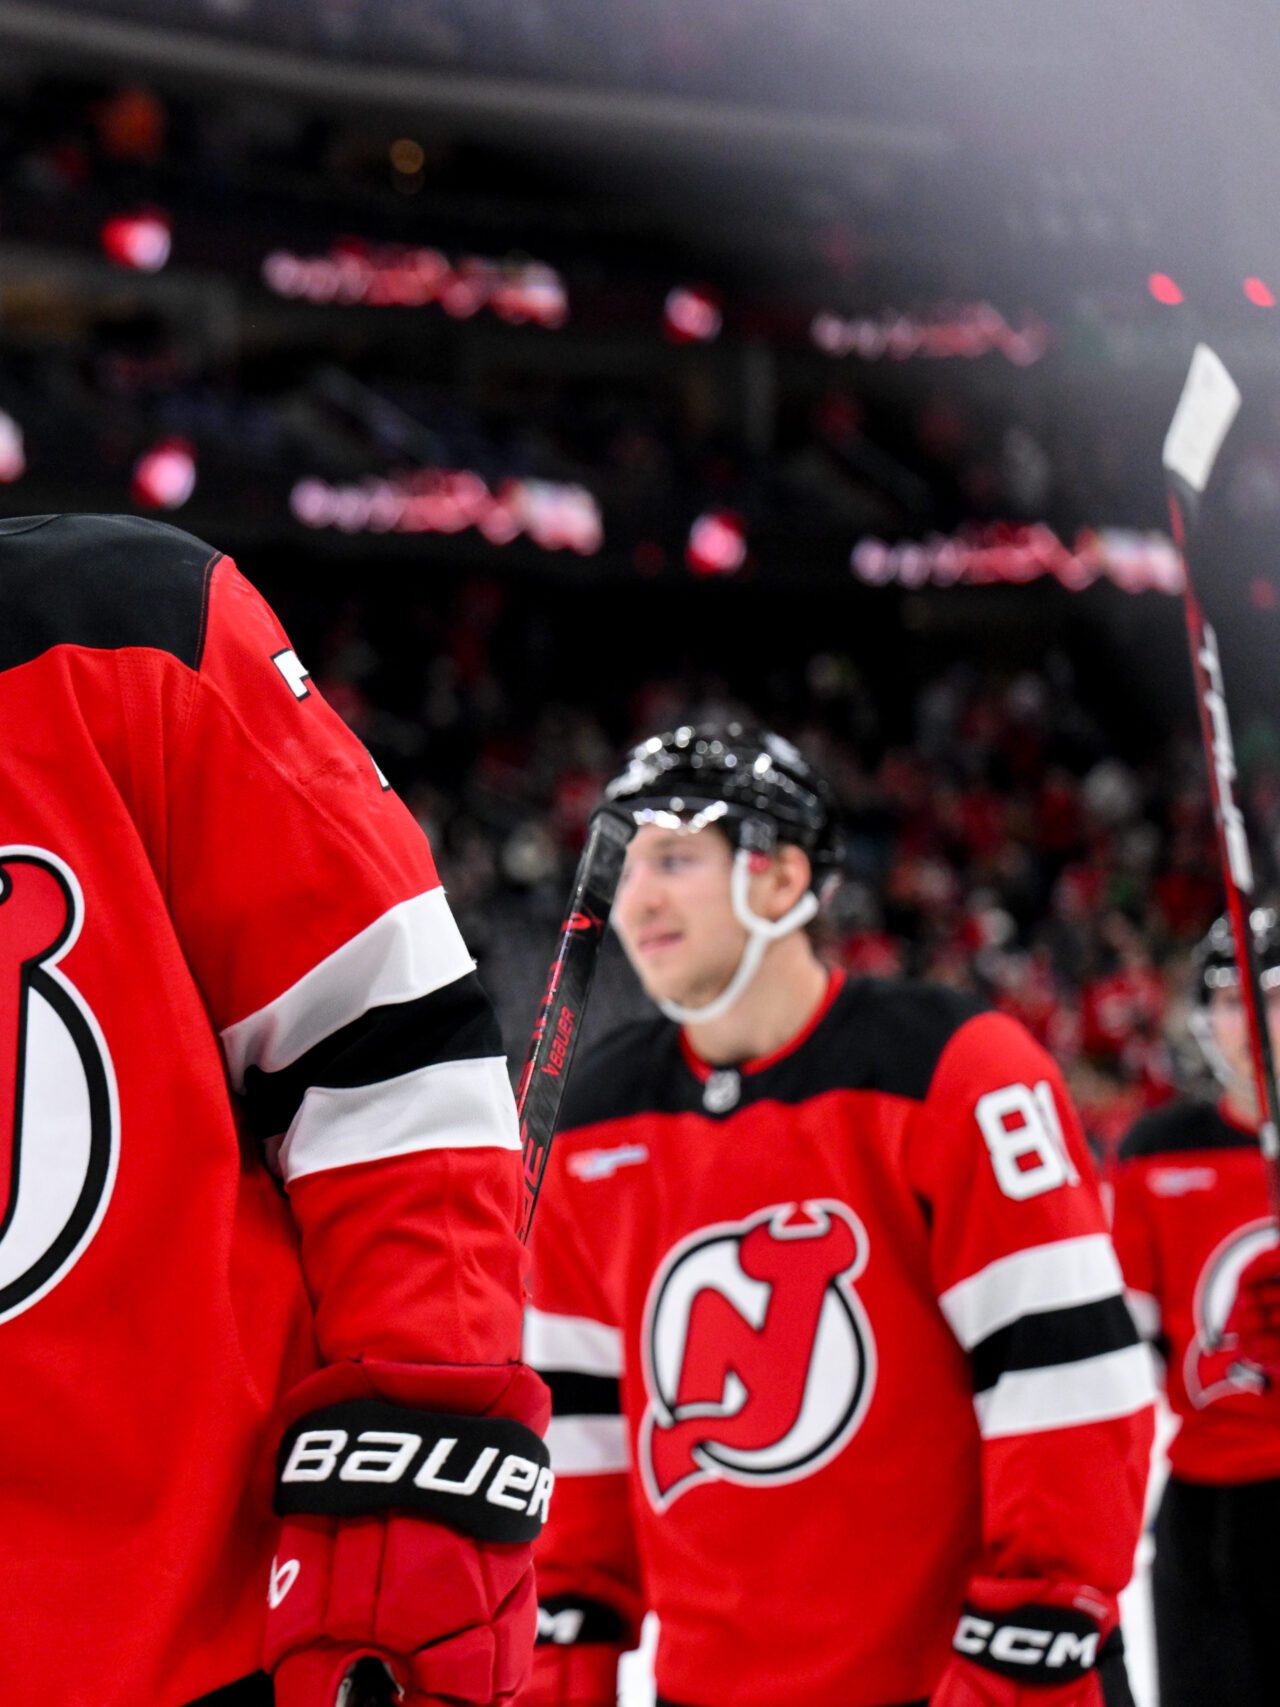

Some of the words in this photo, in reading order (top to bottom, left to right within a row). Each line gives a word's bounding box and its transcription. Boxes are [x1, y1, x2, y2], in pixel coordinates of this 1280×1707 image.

[549, 1006, 575, 1070] BAUER
[973, 1080, 1081, 1202] 81
[952, 1614, 1101, 1669] CCM
